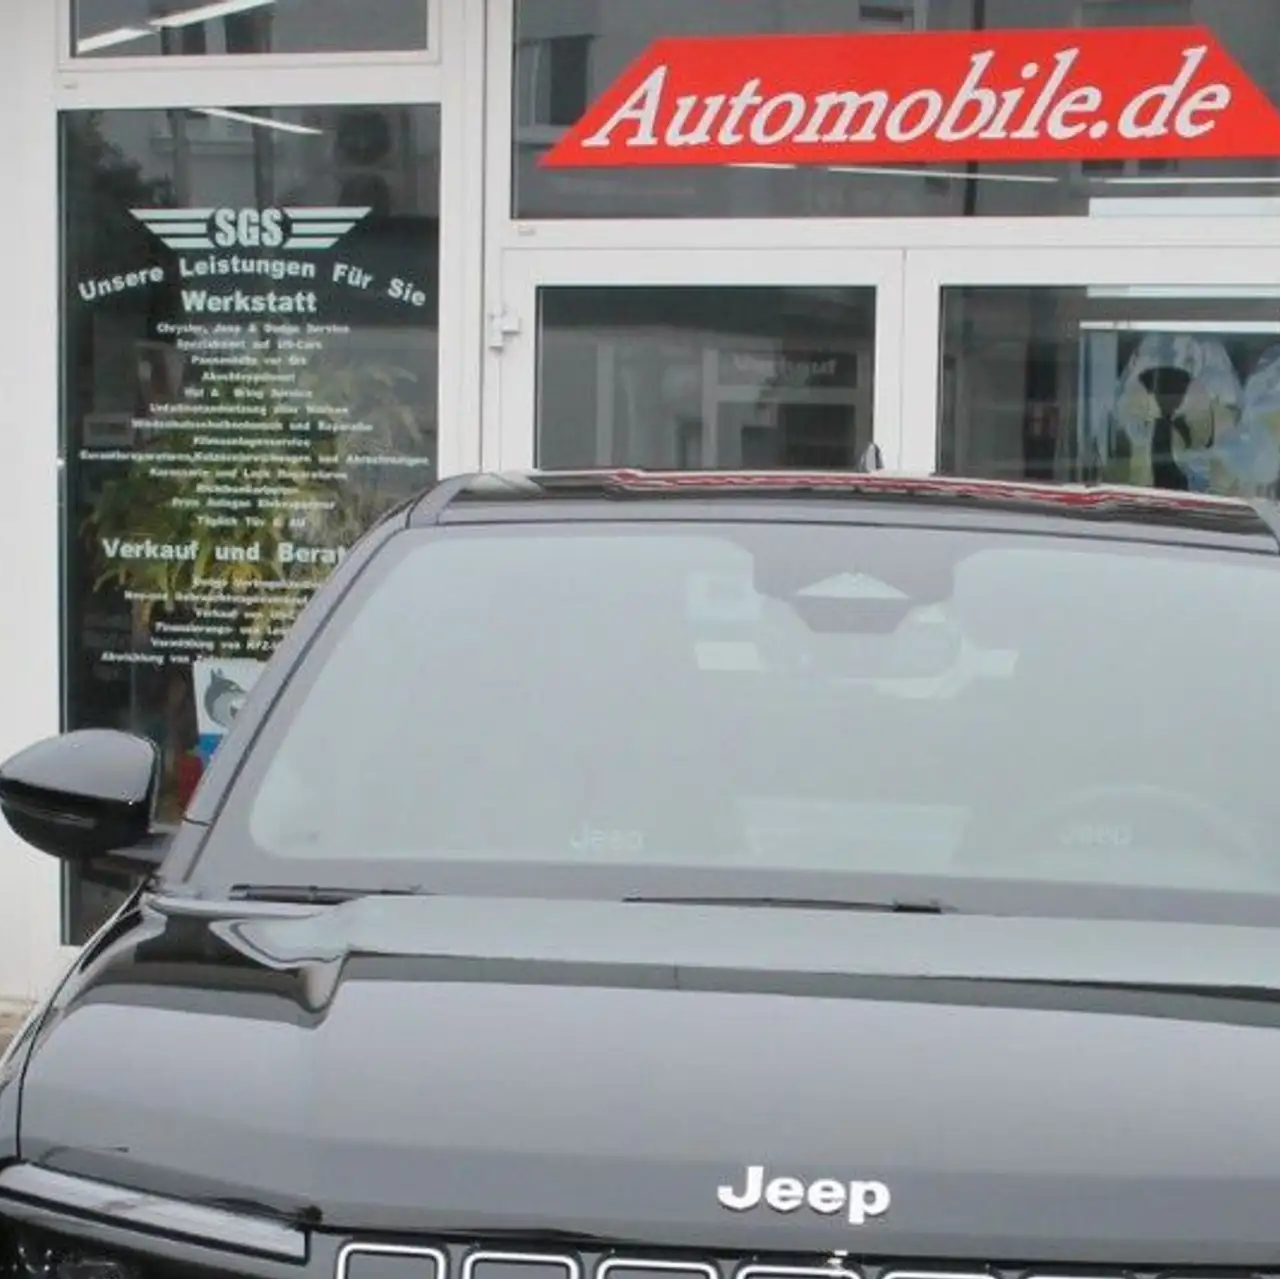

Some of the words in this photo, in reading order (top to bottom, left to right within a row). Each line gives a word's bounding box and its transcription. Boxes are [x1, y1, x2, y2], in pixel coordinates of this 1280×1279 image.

[581, 45, 1233, 148] Automobile.de
[214, 207, 284, 248] SGS
[78, 266, 164, 301] Unsere
[179, 254, 316, 280] Leistungen
[332, 262, 373, 290] Für
[387, 277, 426, 307] Sie
[181, 290, 318, 313] Werkstatt
[102, 538, 199, 560] Verkauf
[215, 541, 260, 561] und
[717, 1165, 891, 1225] Jeep
